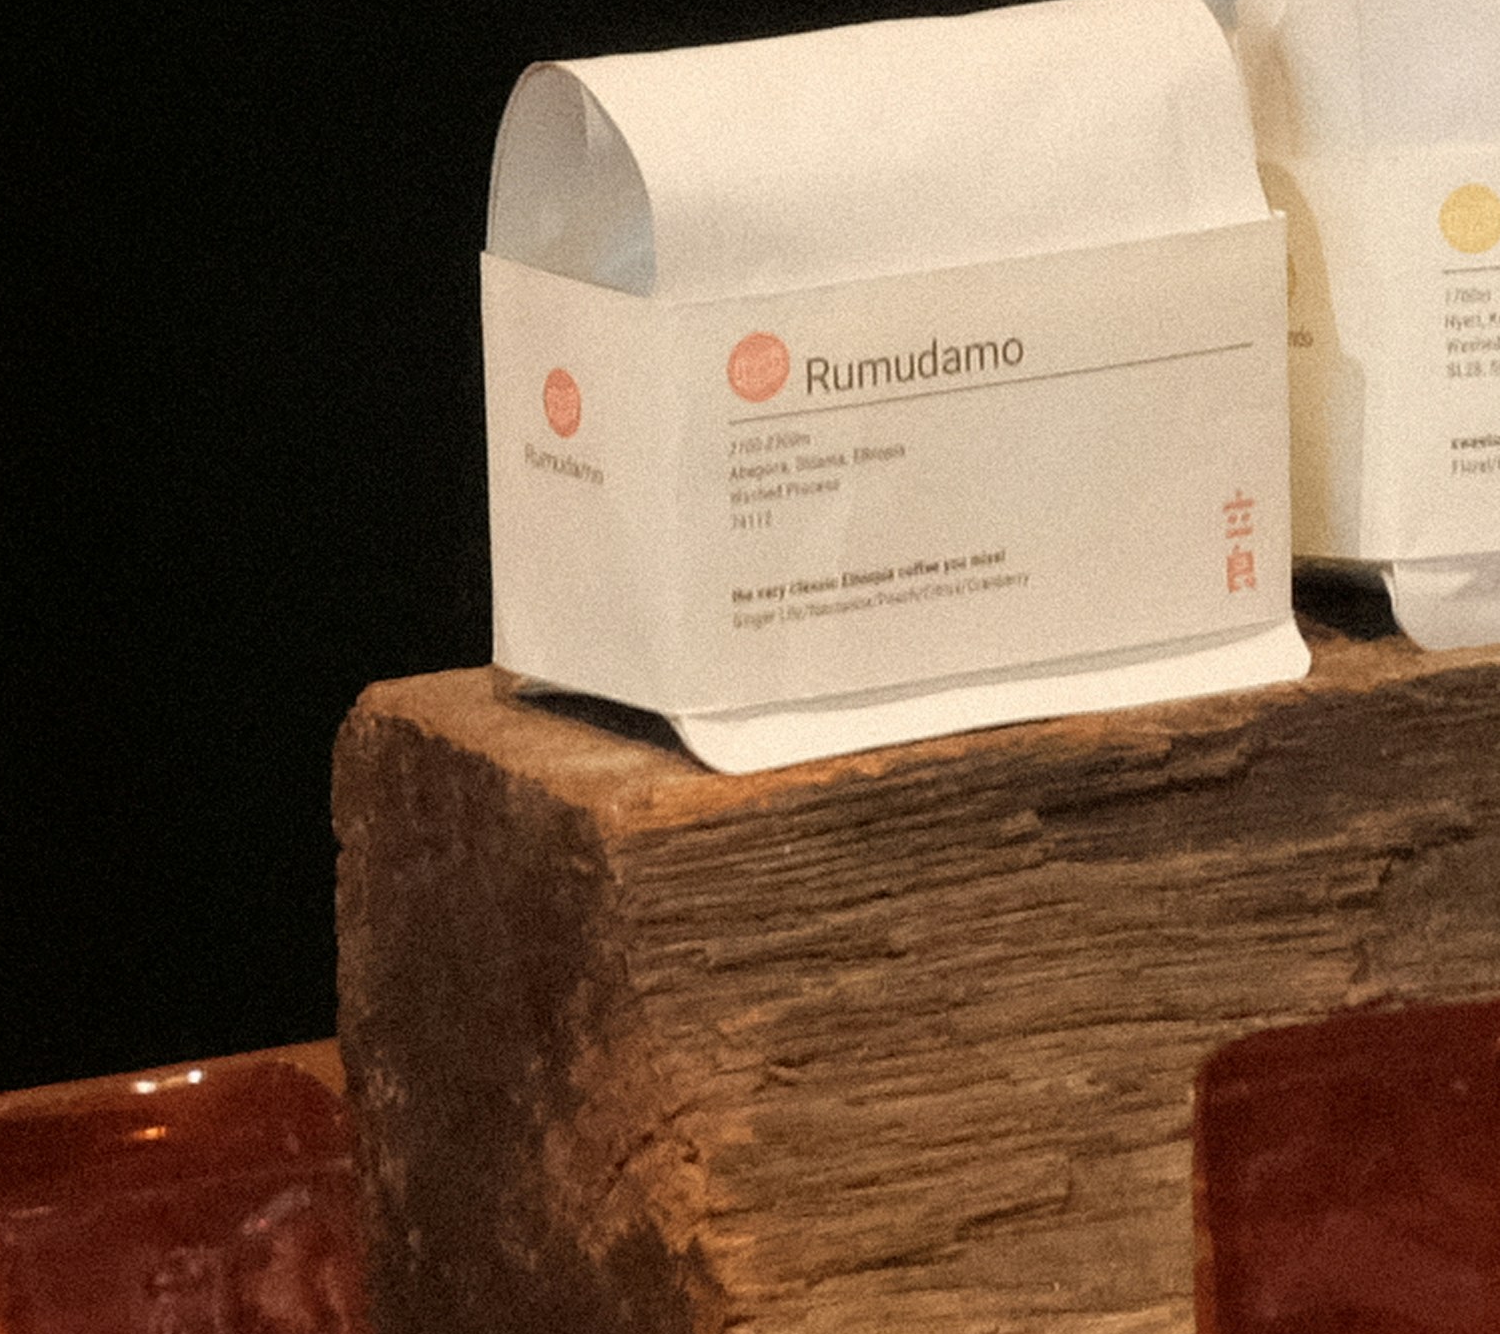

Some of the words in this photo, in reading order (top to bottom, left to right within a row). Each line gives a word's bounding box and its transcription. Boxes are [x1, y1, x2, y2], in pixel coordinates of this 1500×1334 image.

[805, 337, 1025, 395] Rumudamo
[731, 587, 753, 603] the
[756, 585, 785, 602] very
[789, 579, 839, 594] classic
[841, 569, 895, 588] Ethiopia
[897, 561, 940, 578] coffee
[943, 556, 967, 575] you
